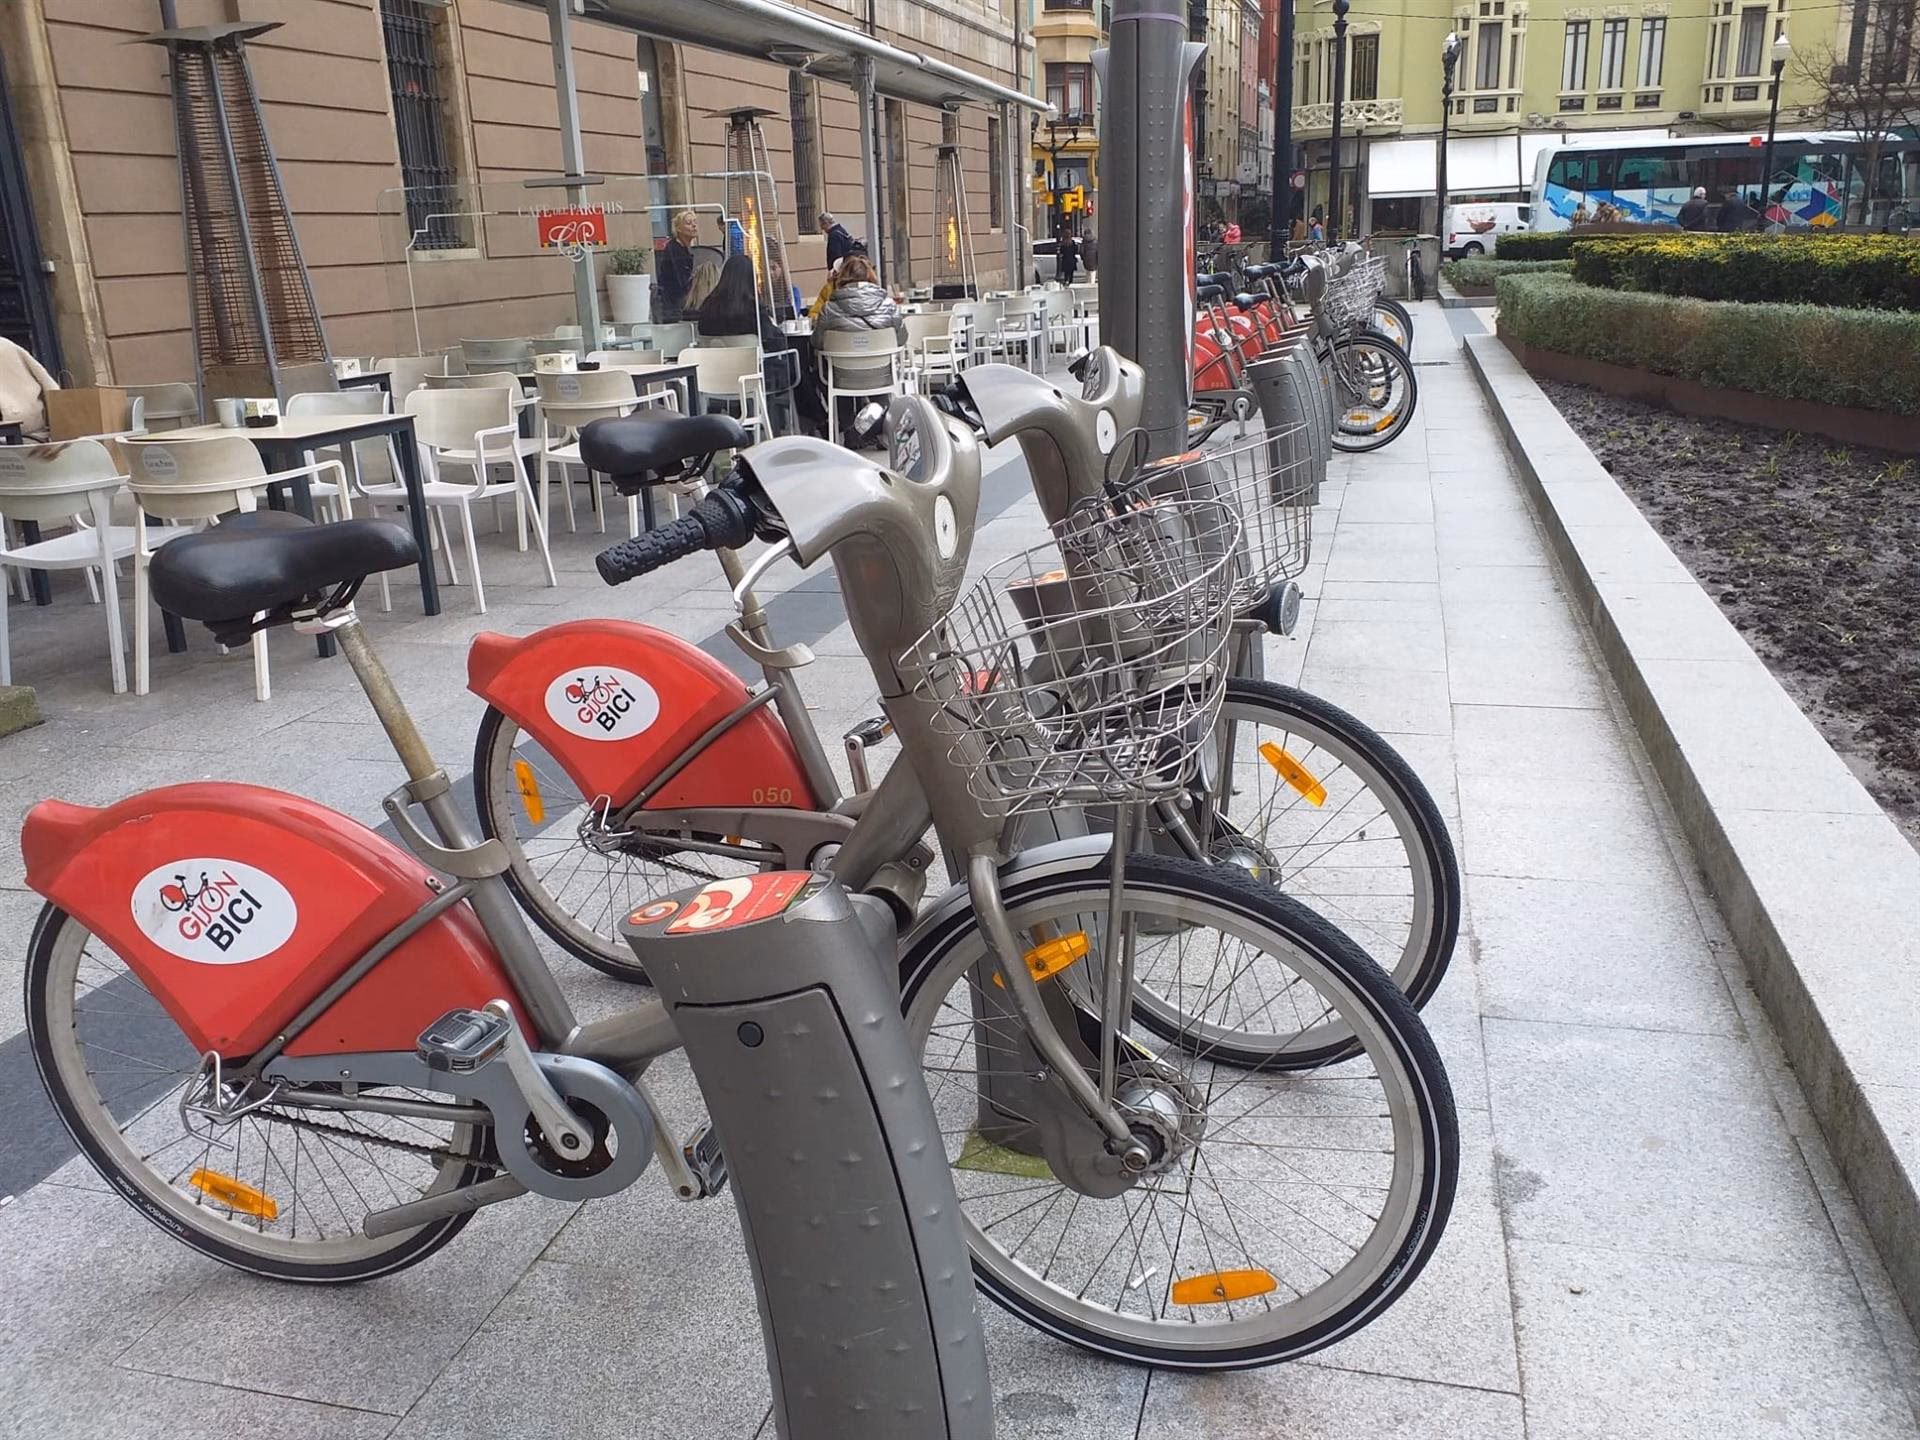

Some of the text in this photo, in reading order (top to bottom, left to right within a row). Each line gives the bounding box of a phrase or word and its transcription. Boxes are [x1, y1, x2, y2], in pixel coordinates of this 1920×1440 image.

[596, 687, 636, 732] BICI
[752, 787, 792, 804] 050
[205, 888, 263, 952] BICI
